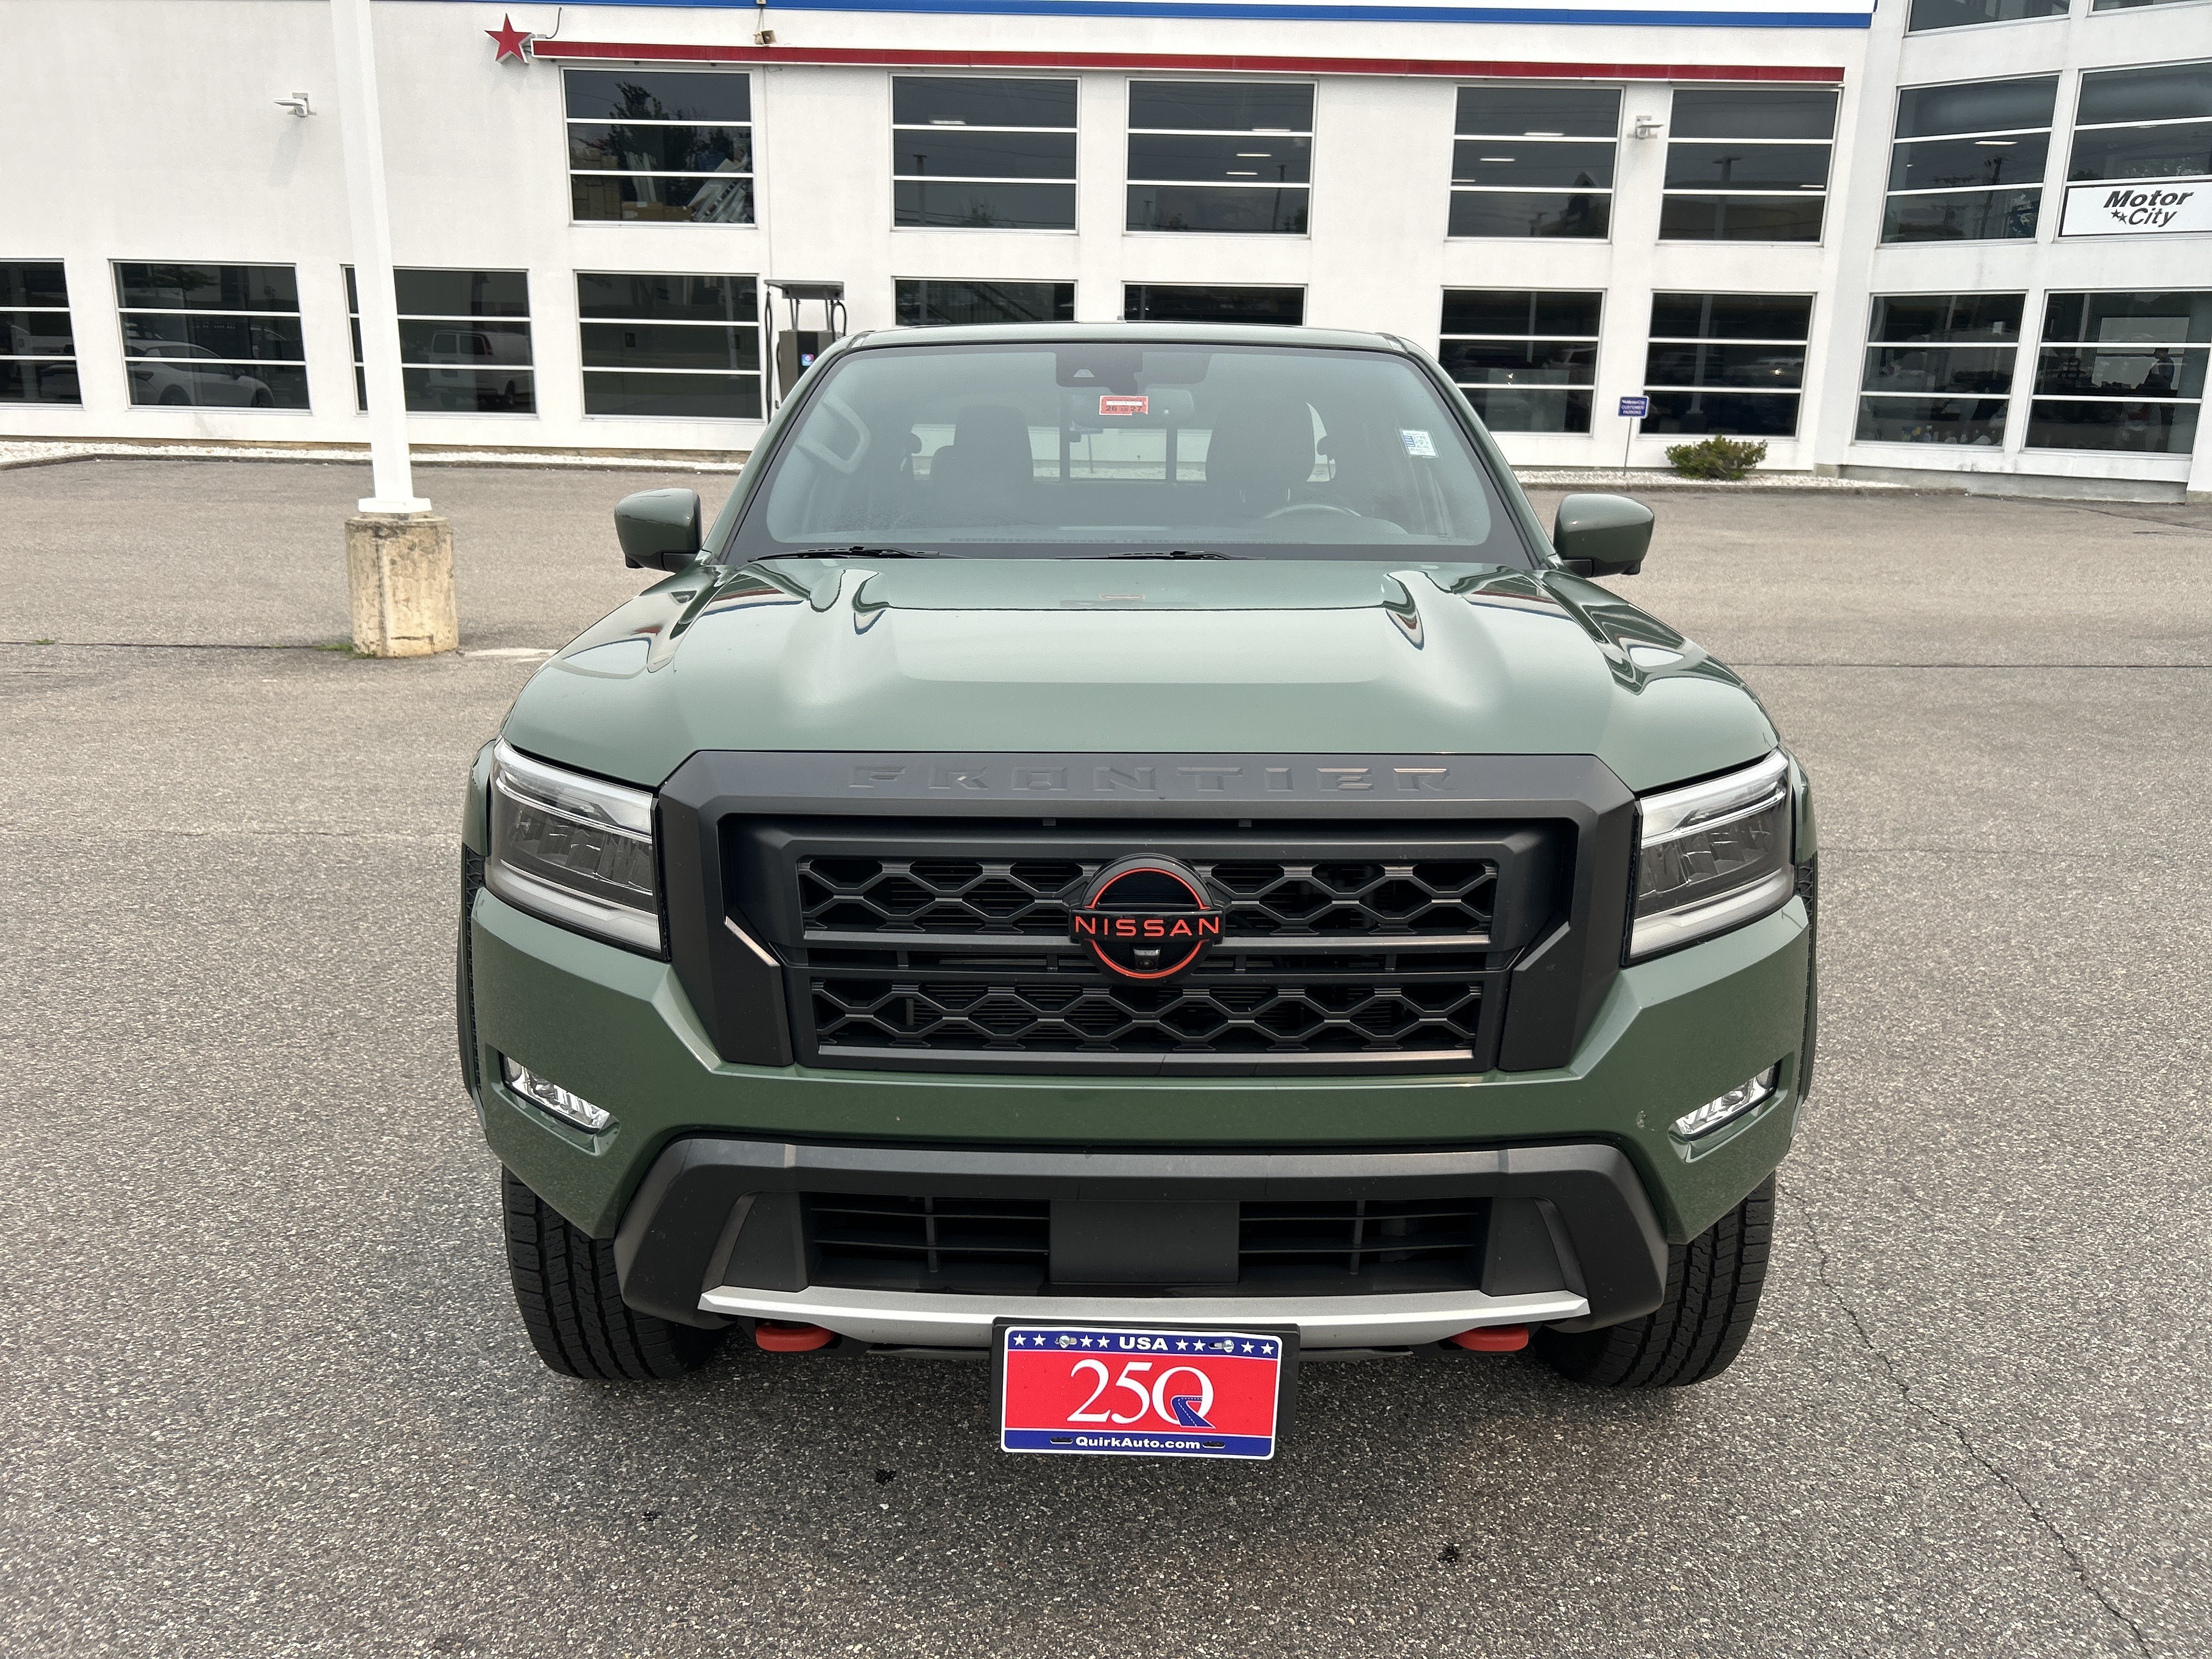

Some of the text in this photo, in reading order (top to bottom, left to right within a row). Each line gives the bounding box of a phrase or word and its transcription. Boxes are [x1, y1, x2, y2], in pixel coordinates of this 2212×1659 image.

[2103, 190, 2194, 208] Motor
[2129, 207, 2178, 227] City
[849, 765, 1459, 792] FRONTIER
[1074, 916, 1220, 937] NISSAN
[1119, 1336, 1168, 1351] USA
[1075, 1436, 1200, 1449] QuirkAuto.com
